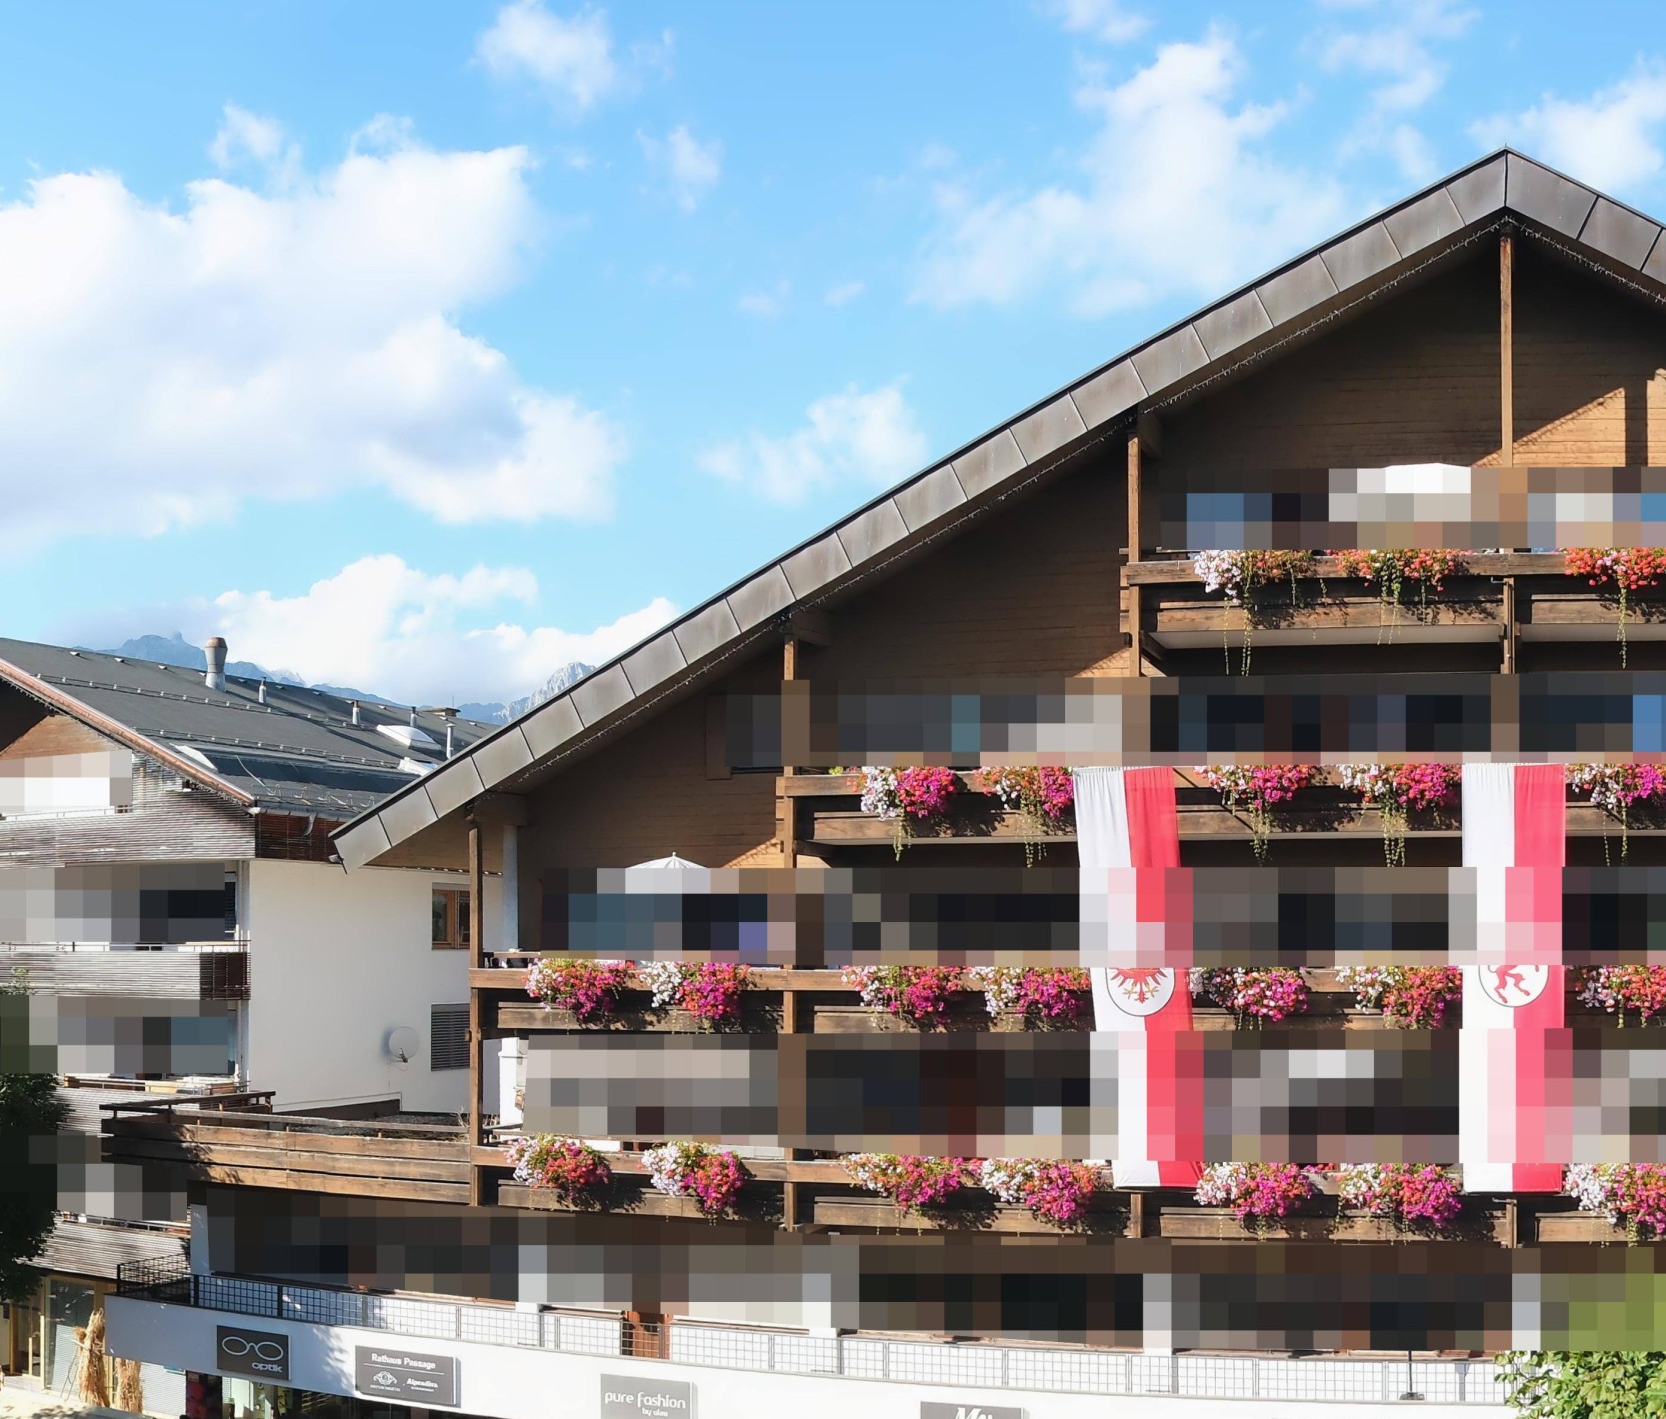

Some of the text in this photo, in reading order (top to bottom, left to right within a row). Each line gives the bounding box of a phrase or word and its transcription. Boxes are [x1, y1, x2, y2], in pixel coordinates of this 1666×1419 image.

[252, 1362, 282, 1373] optik
[371, 1353, 436, 1370] Rathaus Passage
[604, 1391, 686, 1409] pure fashion
[642, 1406, 652, 1417] by
